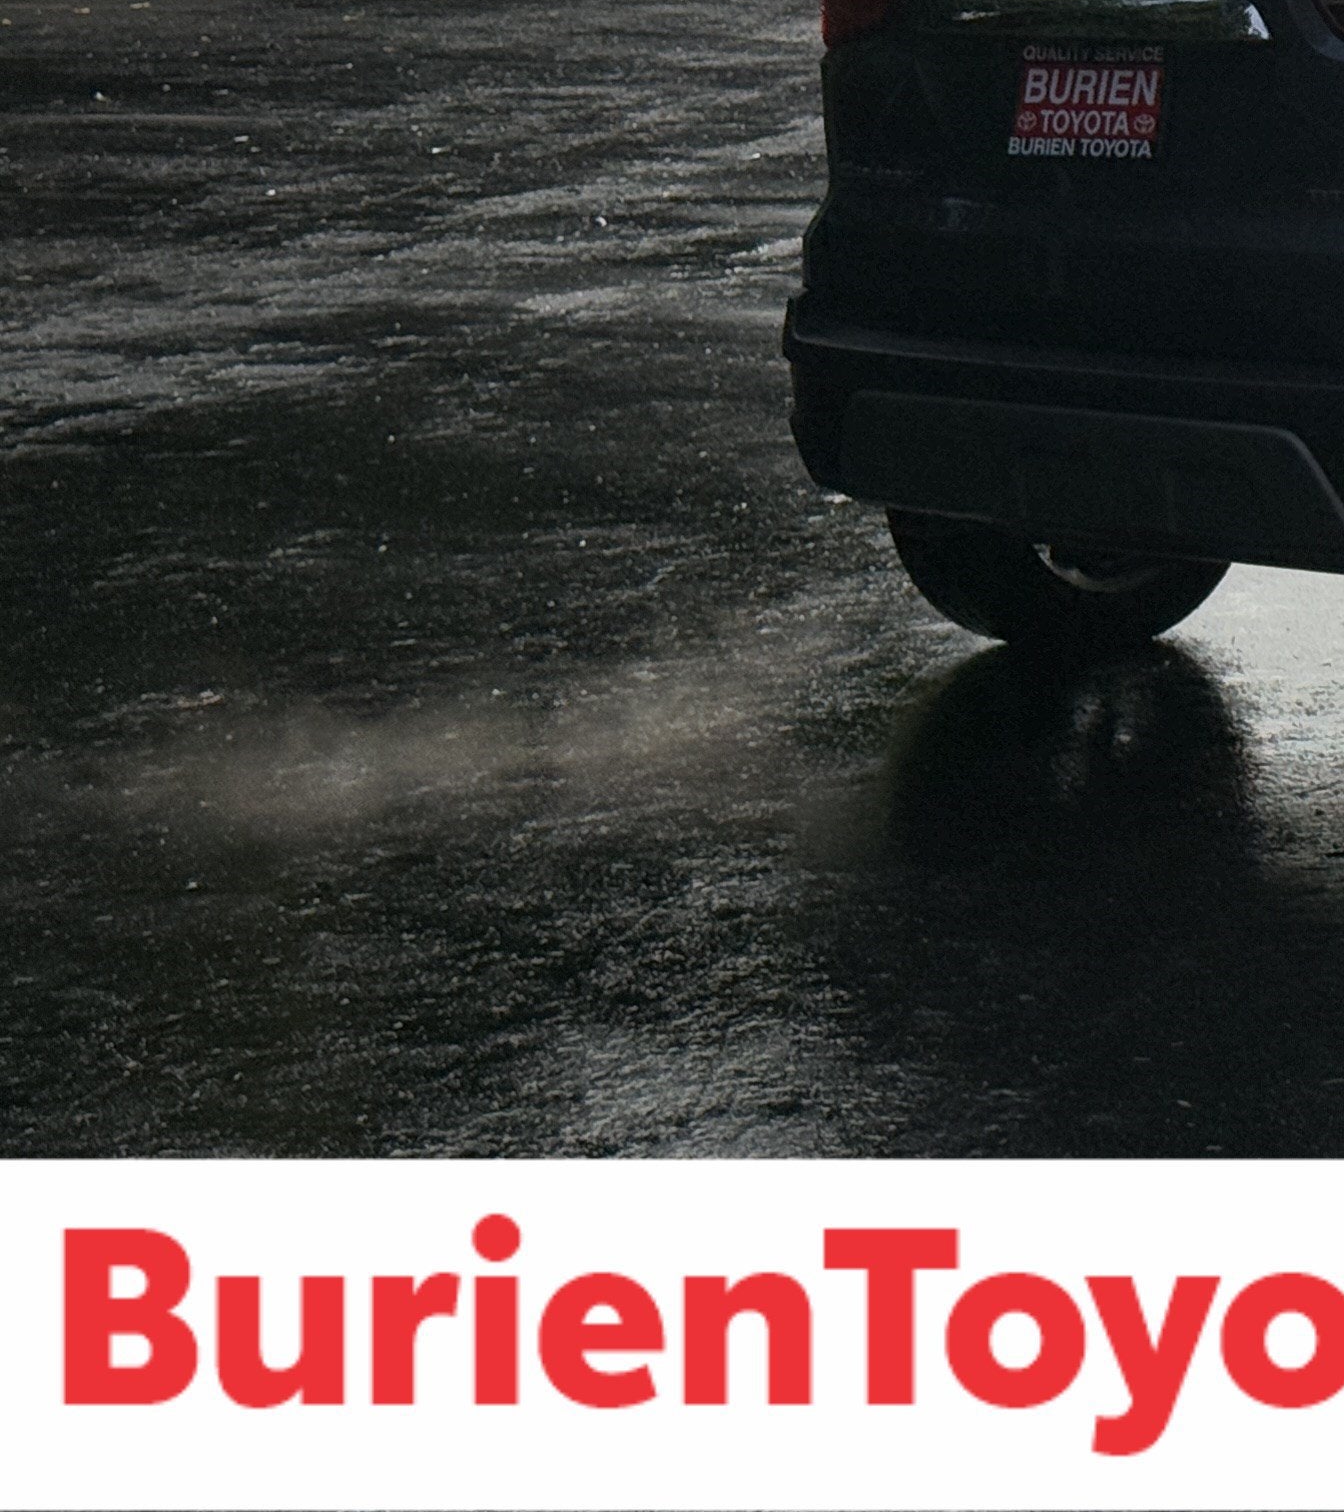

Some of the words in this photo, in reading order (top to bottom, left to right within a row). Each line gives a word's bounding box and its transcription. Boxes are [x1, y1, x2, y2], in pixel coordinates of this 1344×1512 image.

[1022, 44, 1090, 62] QUALITY
[1094, 45, 1165, 63] SERVICE
[1023, 67, 1160, 107] BURIEN
[1040, 109, 1131, 136] TOYOTA
[1007, 136, 1077, 157] BURIEN
[1079, 138, 1154, 160] TOYOTA
